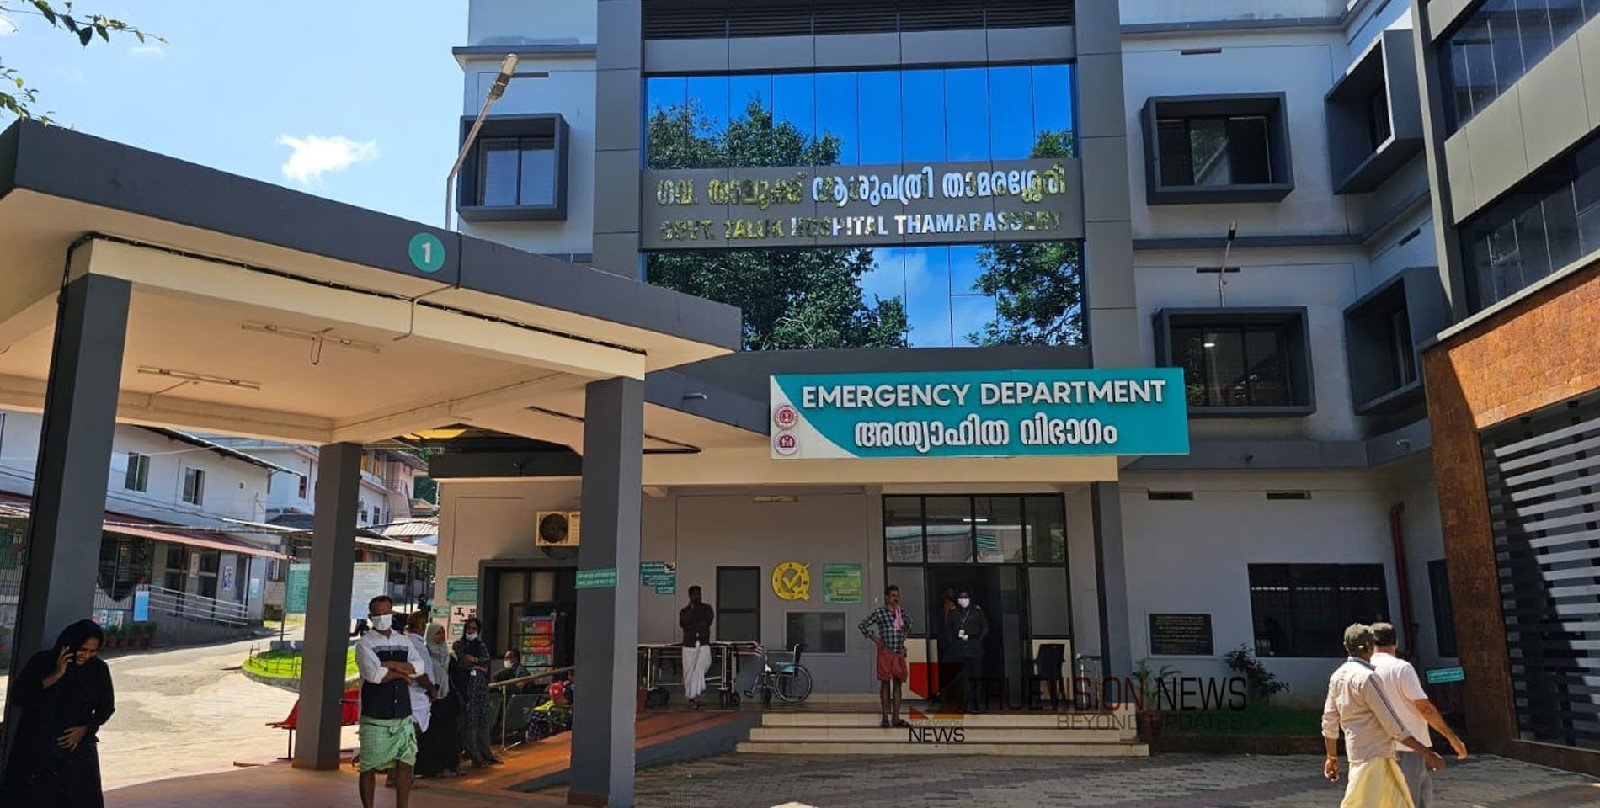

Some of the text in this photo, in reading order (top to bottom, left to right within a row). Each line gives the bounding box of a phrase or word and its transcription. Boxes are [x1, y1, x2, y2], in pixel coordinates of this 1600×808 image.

[812, 165, 934, 206] ആശുപത്രി
[723, 217, 784, 239] TALUK
[791, 214, 889, 237] HOSPITAL
[894, 210, 1062, 234] THAMARASSERY
[421, 241, 431, 264] 1
[802, 379, 1166, 408] EMERGENCY DEPARTMENT
[855, 411, 1118, 453] അത്യാഹിത വിഭാഗം
